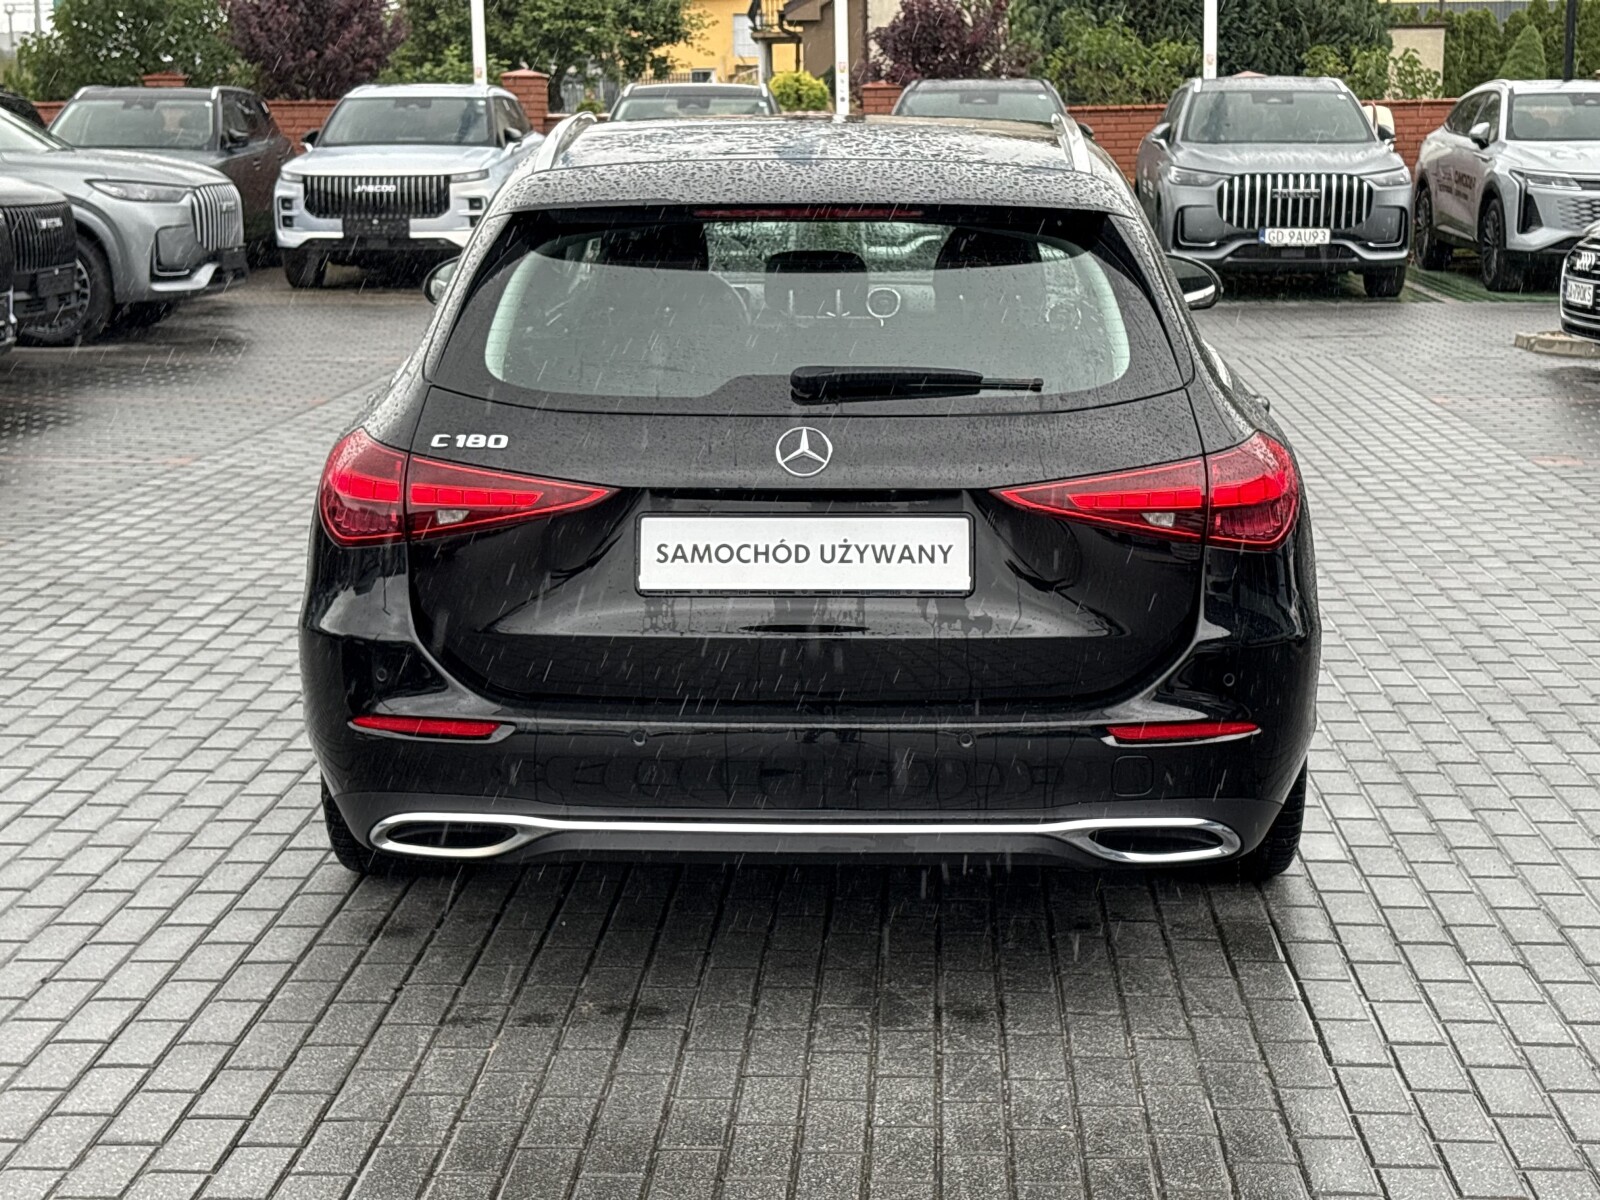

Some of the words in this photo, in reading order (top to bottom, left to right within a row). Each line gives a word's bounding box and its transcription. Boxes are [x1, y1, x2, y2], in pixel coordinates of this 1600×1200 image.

[1268, 230, 1285, 243] GD
[1288, 230, 1327, 243] 9AU93
[430, 433, 452, 448] C
[456, 433, 509, 449] 180
[656, 538, 811, 564] SAMOCHÓD
[820, 538, 954, 564] UŻYWANY
